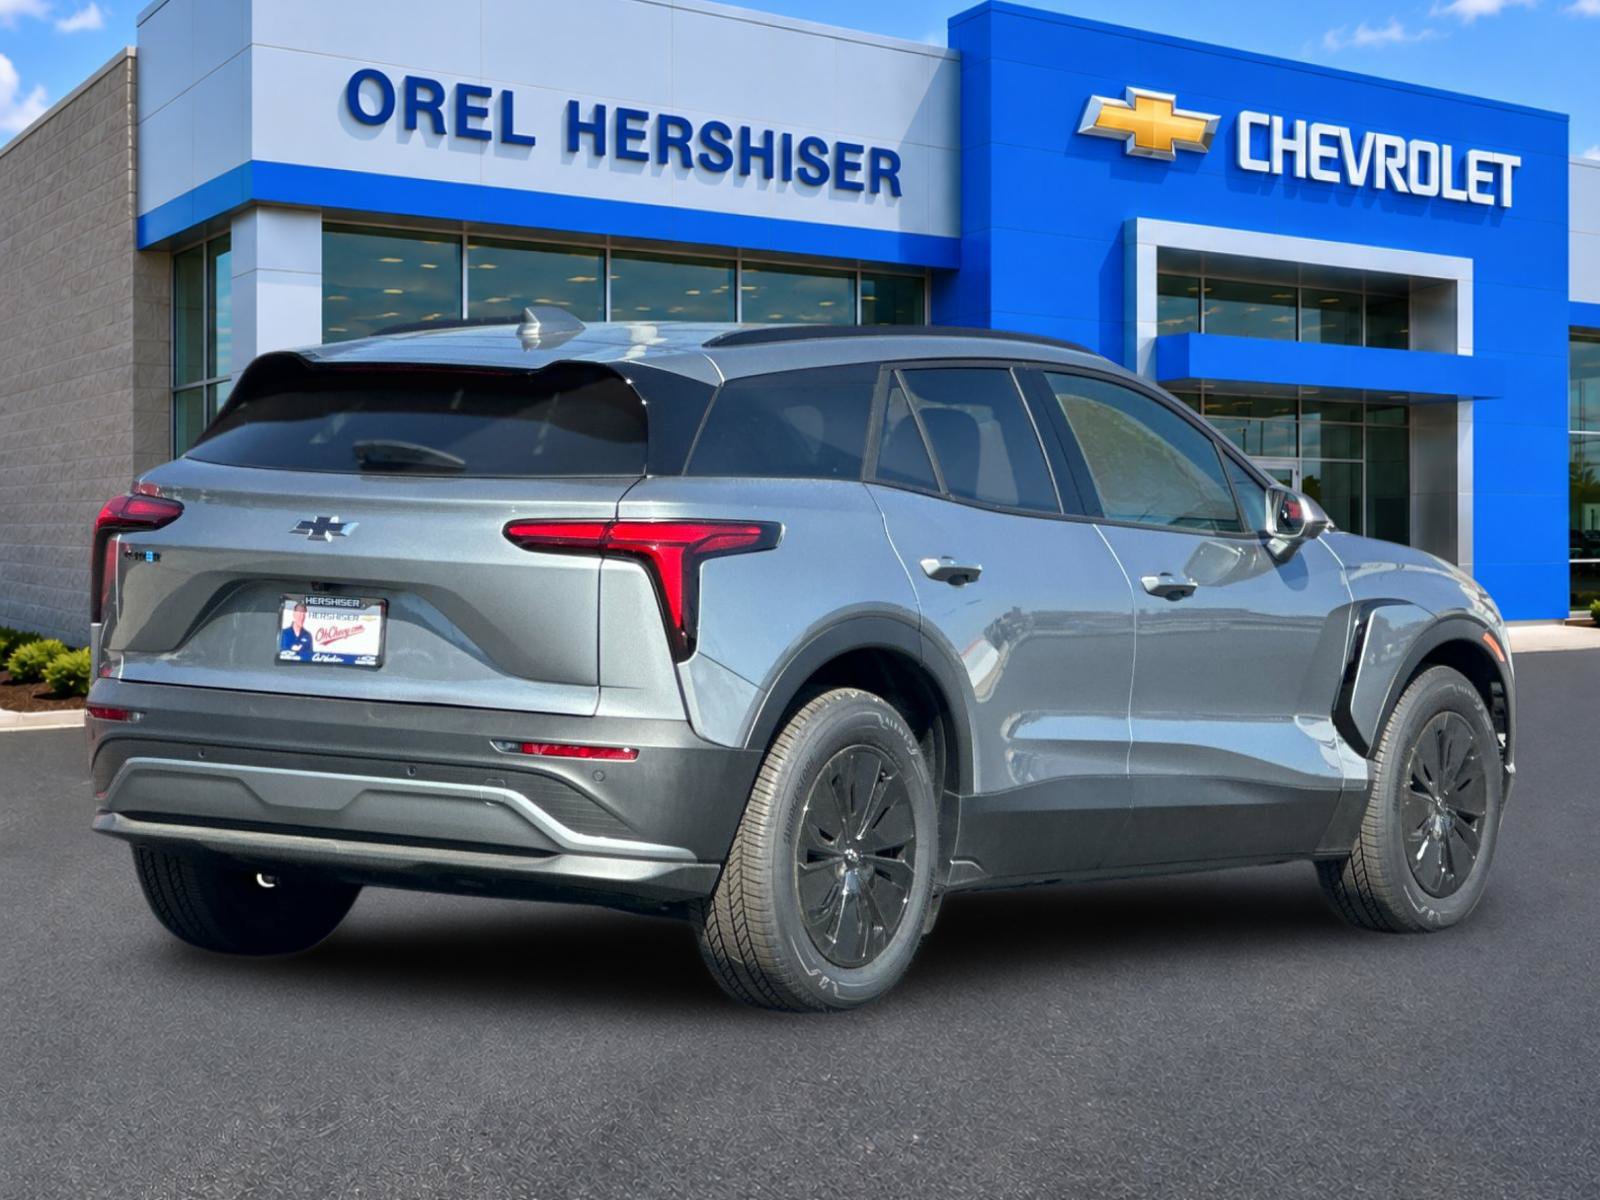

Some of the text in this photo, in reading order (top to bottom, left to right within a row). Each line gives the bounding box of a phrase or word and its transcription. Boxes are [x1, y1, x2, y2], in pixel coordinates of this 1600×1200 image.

[346, 68, 902, 198] OREL HERSHISER
[1237, 110, 1521, 208] CHEVROLET
[305, 596, 360, 607] HERSHISER
